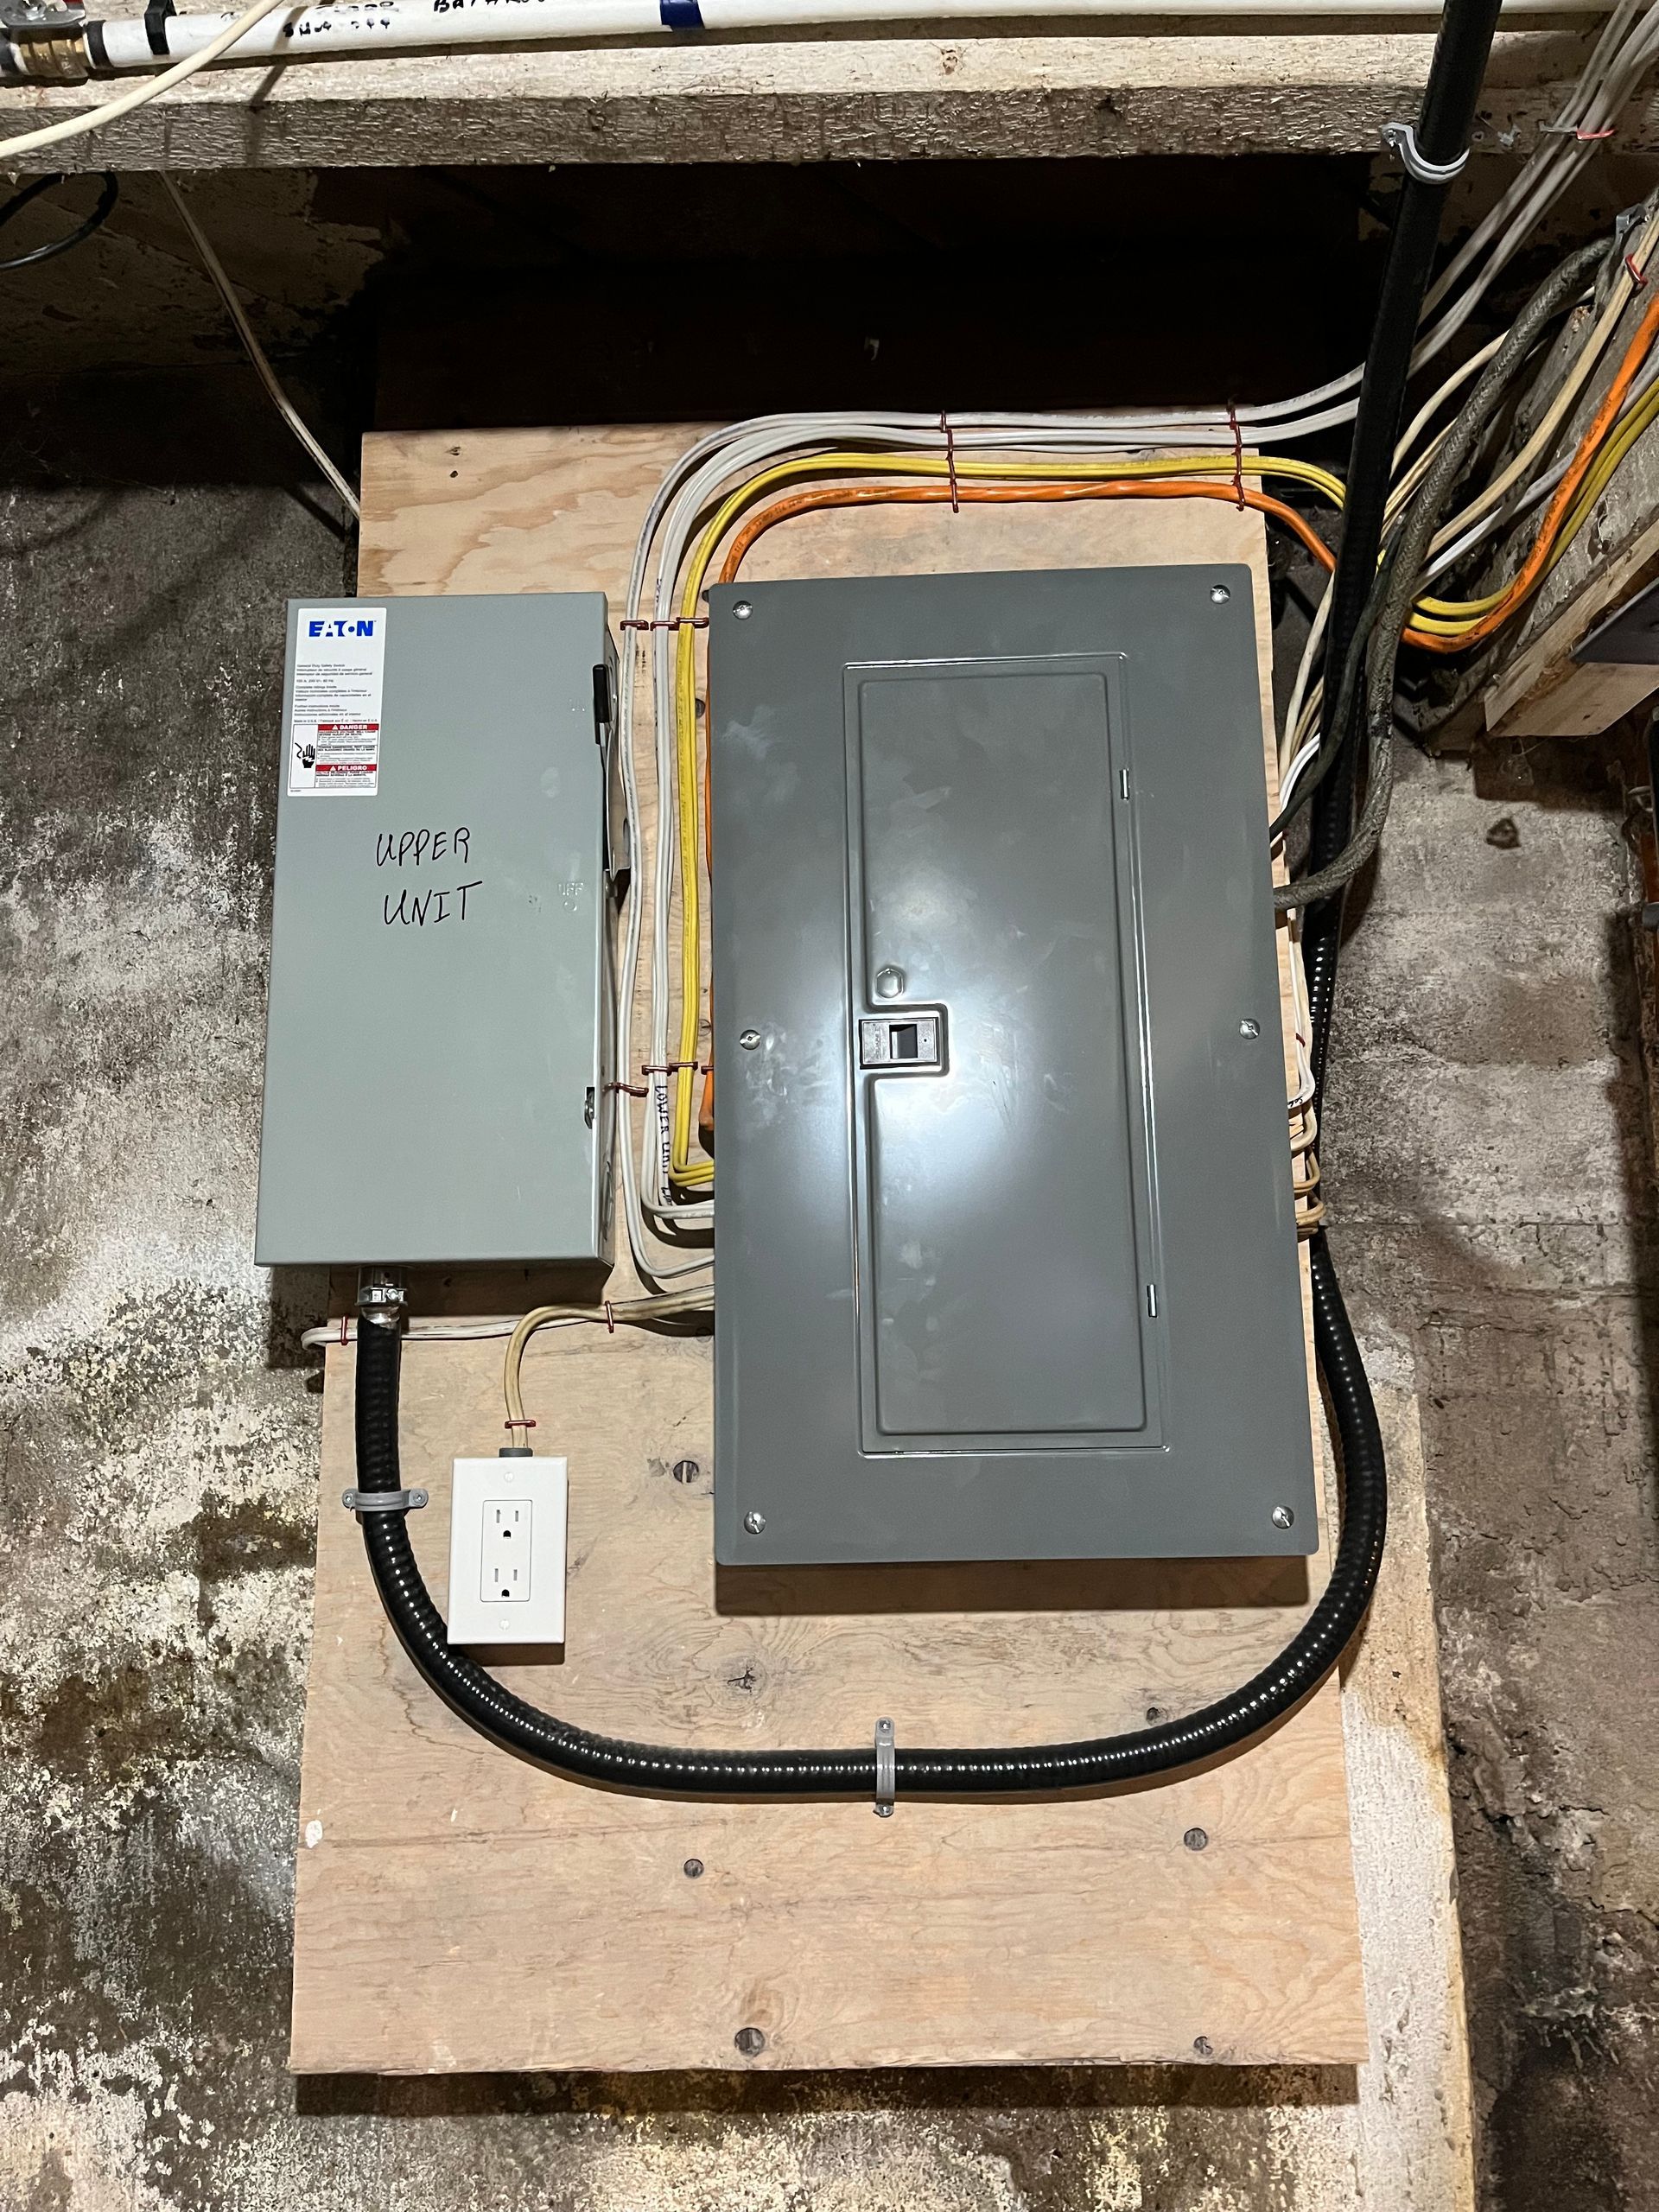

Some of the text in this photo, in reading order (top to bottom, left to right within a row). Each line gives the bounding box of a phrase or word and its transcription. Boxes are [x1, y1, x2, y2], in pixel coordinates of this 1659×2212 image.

[309, 620, 373, 638] EATON
[377, 827, 470, 867] UPPER
[385, 880, 483, 926] UNIT
[655, 1085, 669, 1134] LOWER
